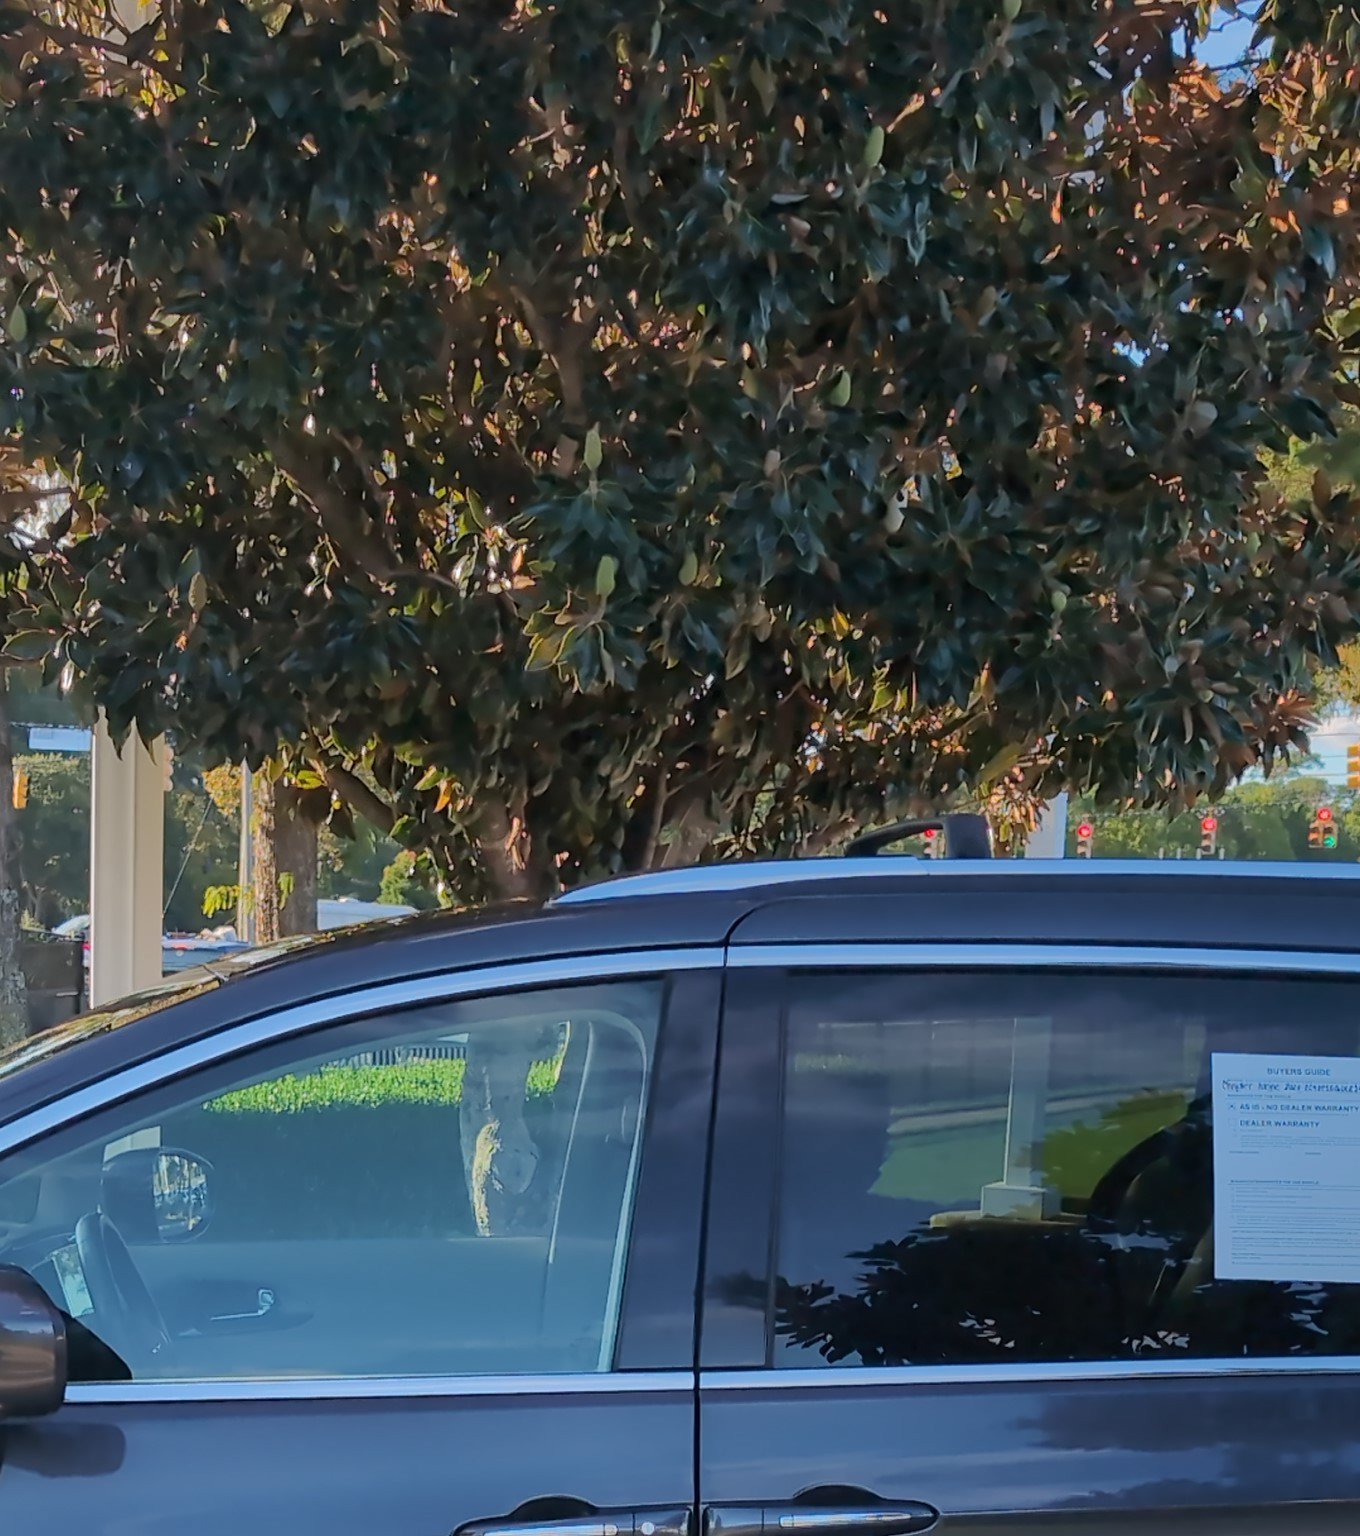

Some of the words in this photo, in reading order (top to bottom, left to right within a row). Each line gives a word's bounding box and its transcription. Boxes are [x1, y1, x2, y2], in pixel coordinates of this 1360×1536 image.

[1267, 1067, 1302, 1076] BUYERS
[1304, 1067, 1332, 1076] GUIDE
[1240, 1103, 1250, 1111] AS
[1280, 1104, 1312, 1112] DEALER
[1314, 1105, 1359, 1113] WARRANTY
[1240, 1119, 1272, 1128] DEALER
[1274, 1120, 1320, 1128] WARRANTY
